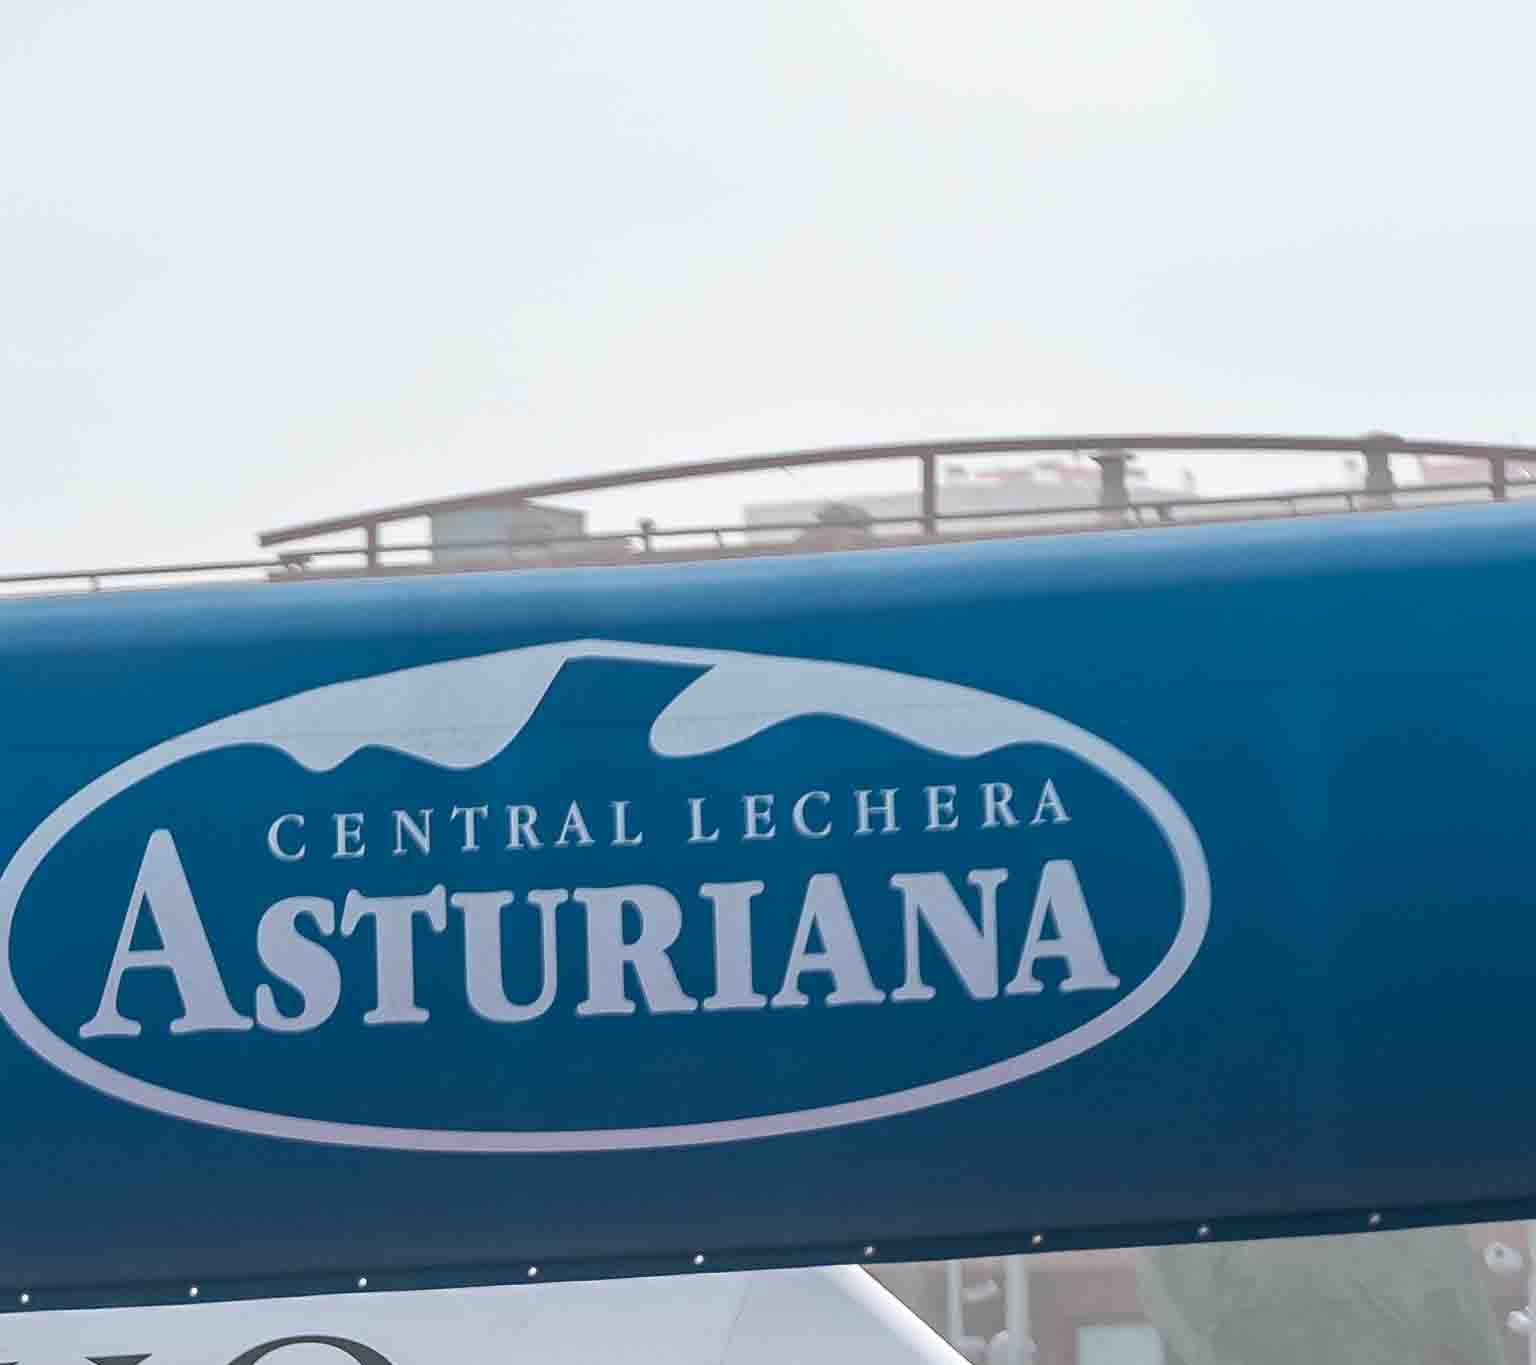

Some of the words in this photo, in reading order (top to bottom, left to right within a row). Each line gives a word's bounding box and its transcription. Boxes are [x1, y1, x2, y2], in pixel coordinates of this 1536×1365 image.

[268, 799, 645, 862] CENTRAL
[688, 777, 1074, 846] LECHERA
[79, 829, 1120, 1040] ASTURIANA
